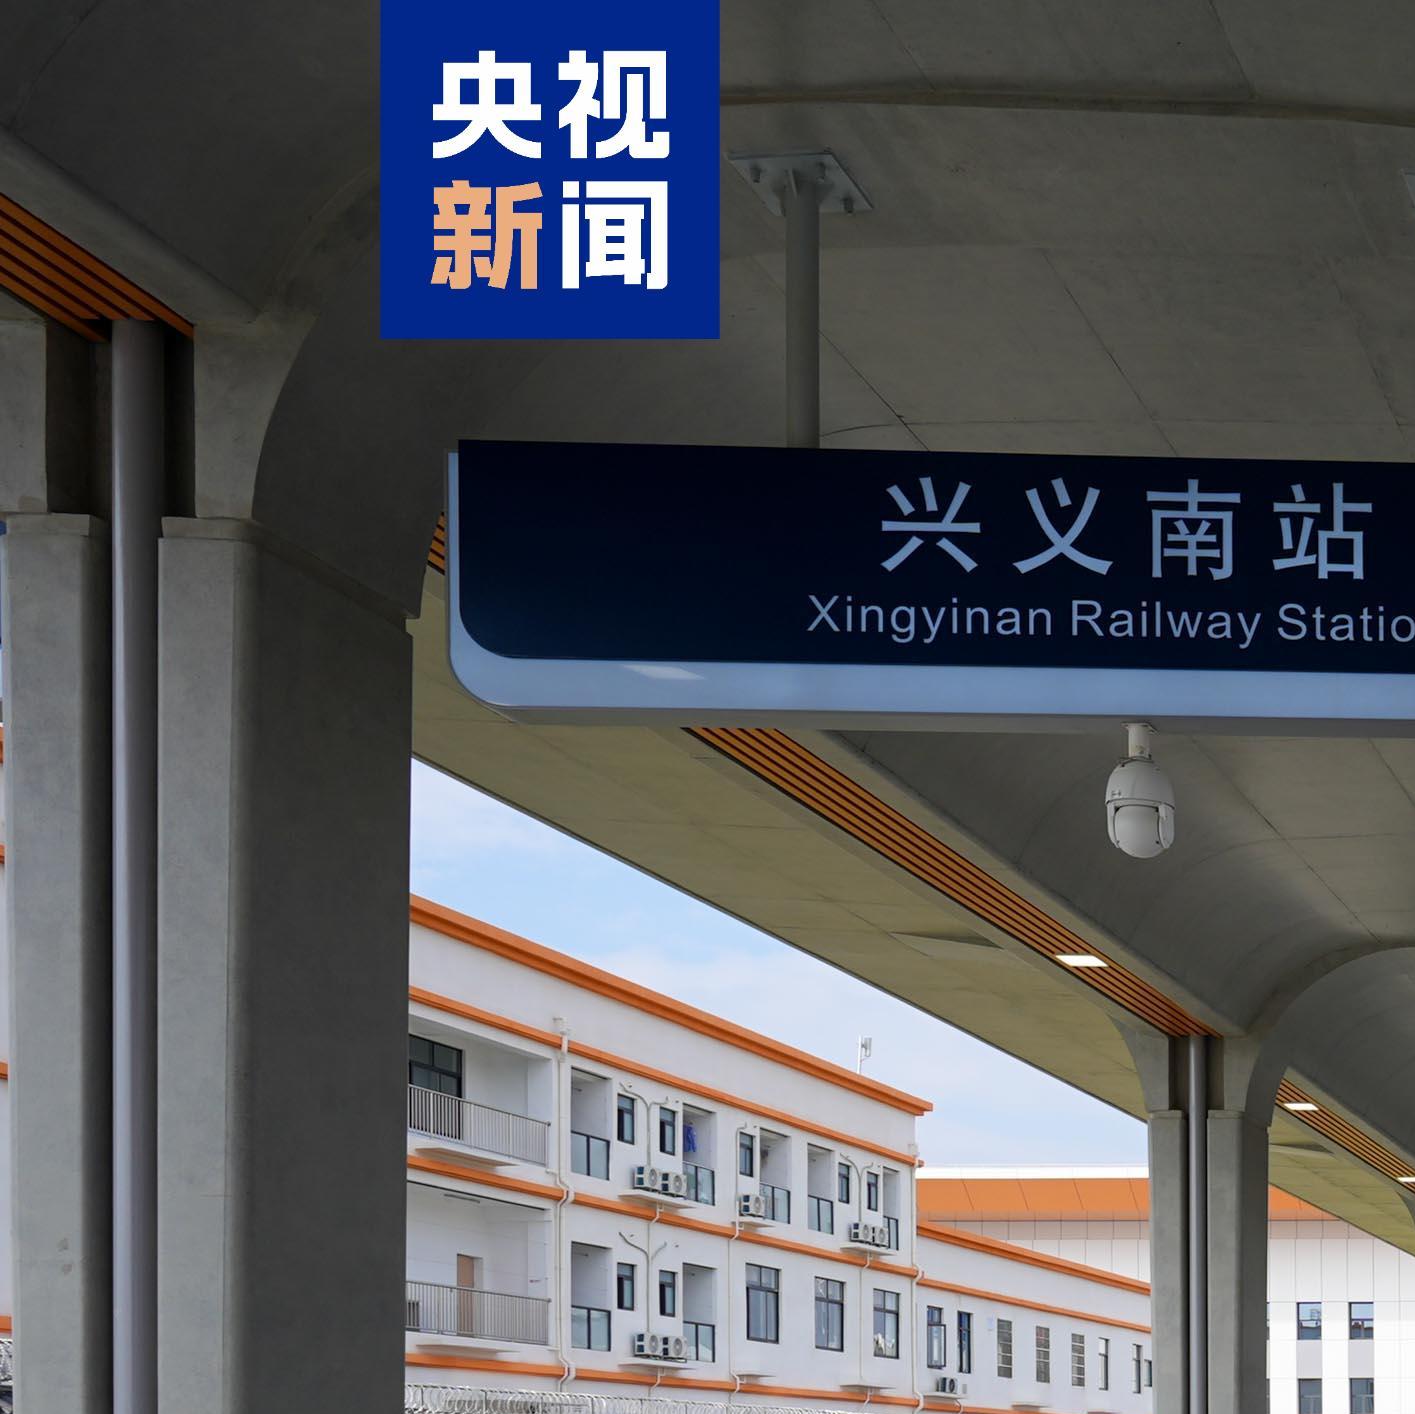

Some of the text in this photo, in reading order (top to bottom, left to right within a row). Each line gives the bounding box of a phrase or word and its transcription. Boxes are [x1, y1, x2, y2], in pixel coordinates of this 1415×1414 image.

[880, 476, 1373, 581] 兴义南站
[807, 595, 1053, 644] Xingyinan
[1070, 600, 1262, 649] Railway
